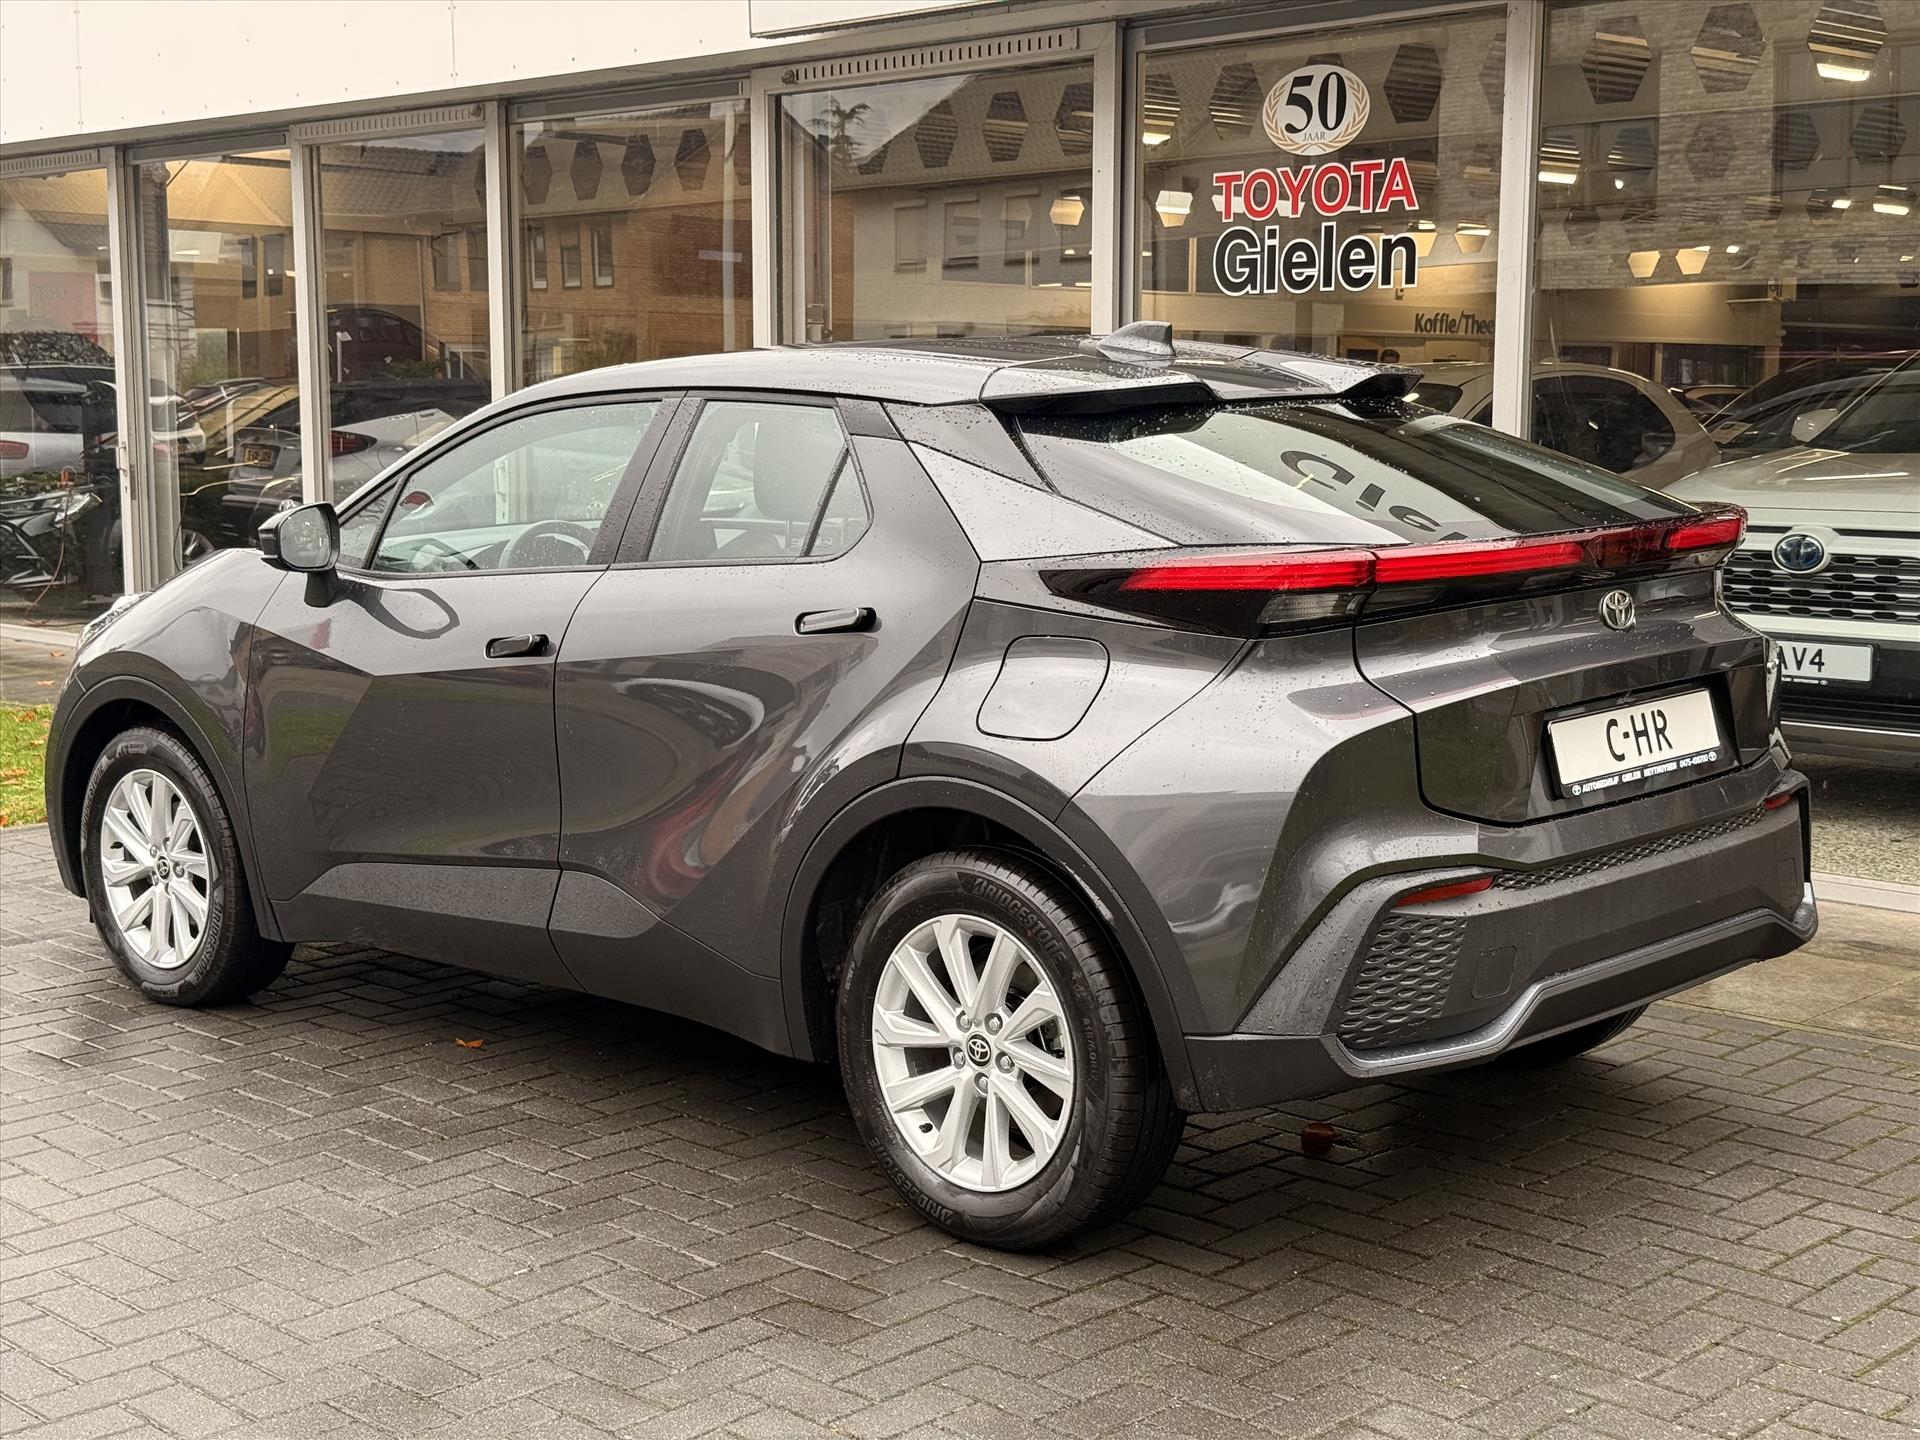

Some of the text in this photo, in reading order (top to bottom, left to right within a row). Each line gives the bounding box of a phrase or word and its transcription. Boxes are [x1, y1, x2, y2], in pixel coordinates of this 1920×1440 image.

[1285, 72, 1347, 134] 50
[1303, 131, 1326, 142] JAAR
[1213, 157, 1419, 222] TOYOTA
[1213, 222, 1419, 296] Gielen
[1606, 709, 1674, 762] C-HR
[193, 901, 224, 981] BRIDGESTONE
[972, 878, 1067, 961] BRIDGESTONE
[868, 1137, 954, 1225] BRIDGESTONE
